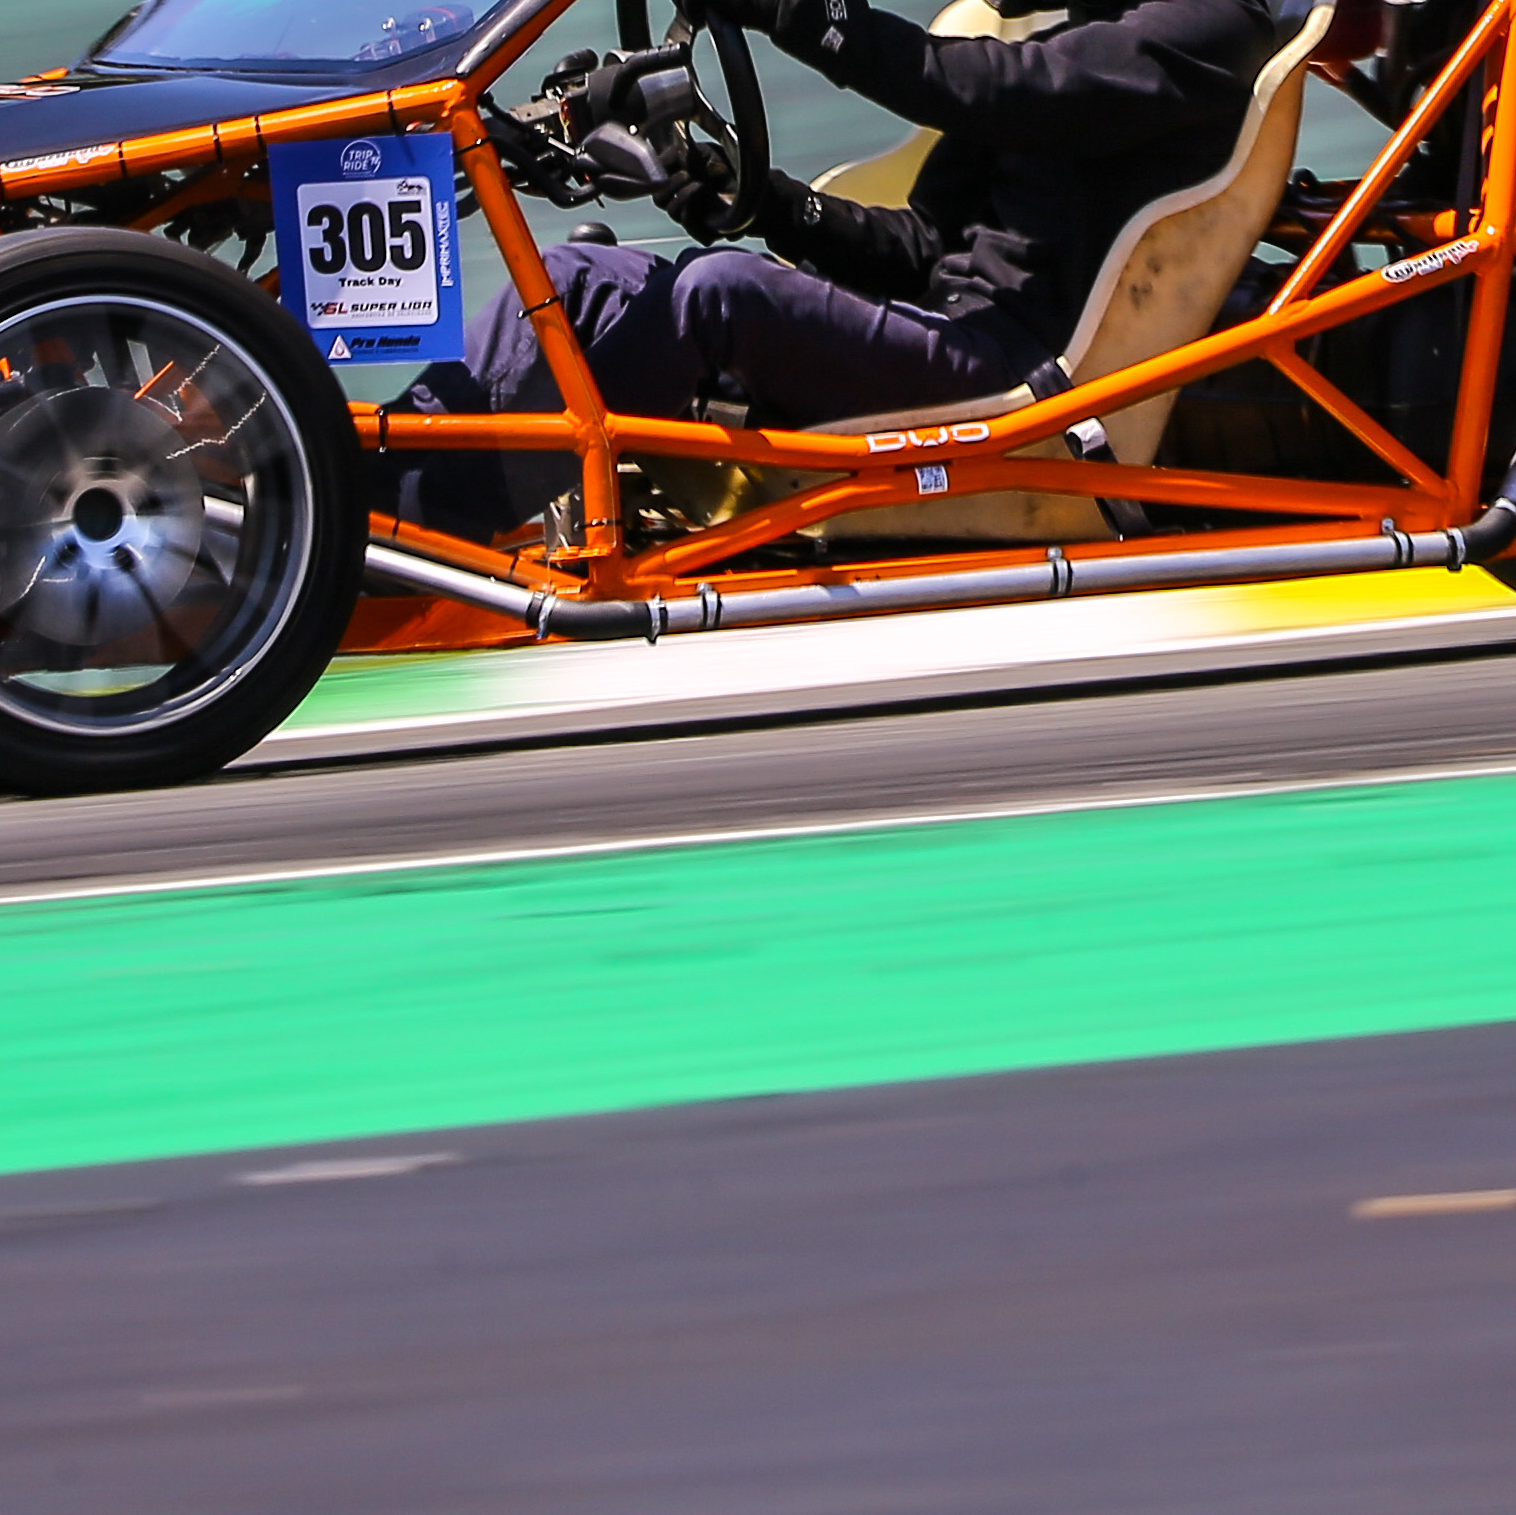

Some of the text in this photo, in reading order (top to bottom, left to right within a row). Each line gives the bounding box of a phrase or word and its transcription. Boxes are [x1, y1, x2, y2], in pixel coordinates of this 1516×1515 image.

[348, 149, 373, 161] TRIP
[343, 160, 368, 171] RIDE
[307, 199, 426, 275] 305
[338, 276, 402, 288] Track Day
[350, 301, 397, 312] SUPER
